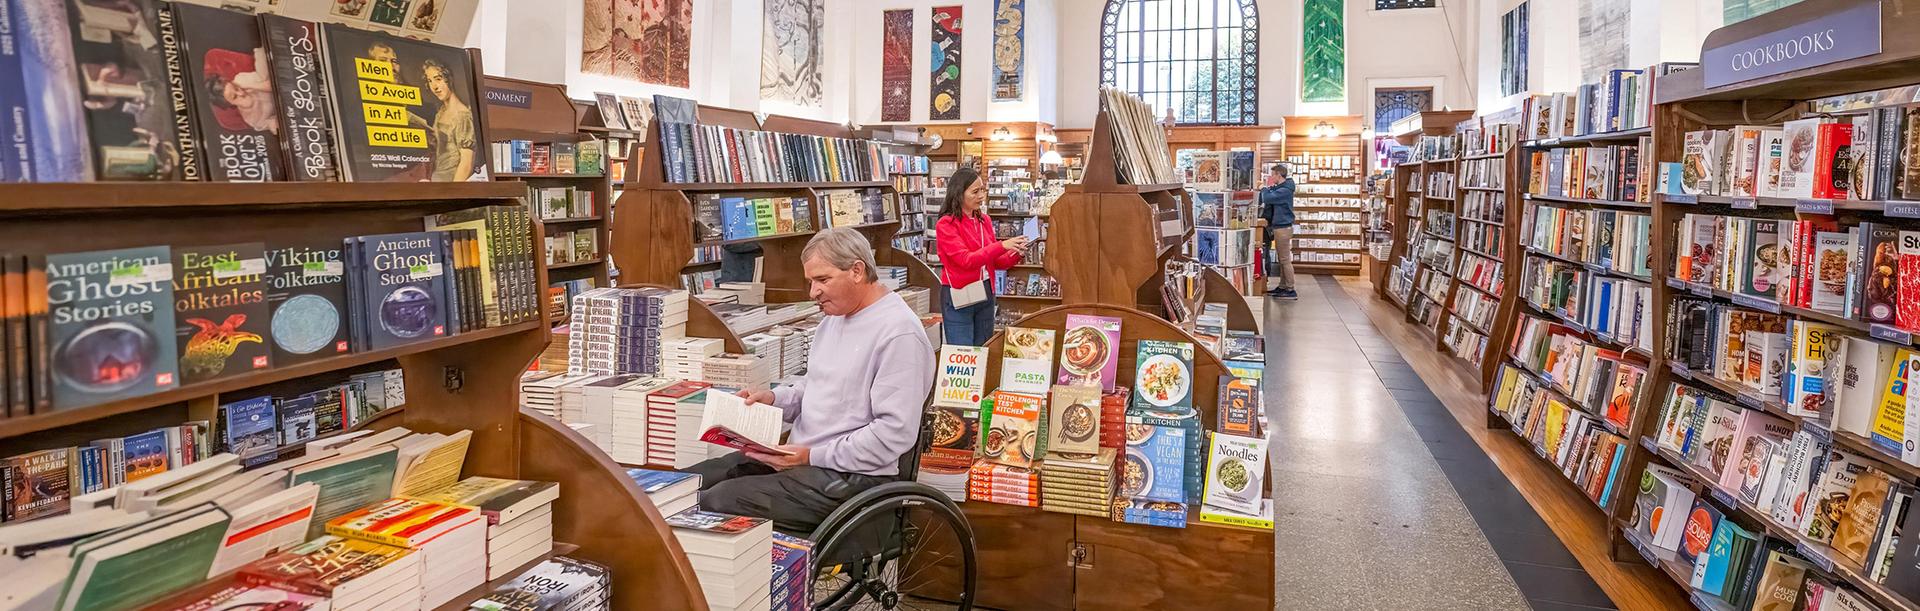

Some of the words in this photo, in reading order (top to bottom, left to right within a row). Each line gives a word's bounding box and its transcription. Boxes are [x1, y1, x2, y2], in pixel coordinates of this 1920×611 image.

[1731, 29, 1836, 72] COOKBOOKS
[158, 9, 188, 111] WOLSTENHOLME
[288, 26, 314, 112] Lovers
[361, 62, 389, 76] Men
[366, 84, 378, 96] to
[382, 87, 416, 99] Avoid
[369, 107, 381, 118] in
[384, 109, 402, 120] Art
[291, 119, 302, 151] Calendar
[373, 131, 398, 142] and
[401, 132, 420, 143] Life
[220, 134, 241, 178] BOOK
[299, 117, 325, 178] Book
[402, 155, 430, 163] Calendar
[1893, 206, 1918, 215] CHEESE
[513, 211, 521, 234] DONNA
[1757, 222, 1775, 231] EAT
[376, 238, 432, 251] Ancient
[515, 236, 523, 254] LEON
[525, 236, 533, 253] LEON
[183, 251, 238, 270] East
[264, 247, 341, 268] Viking
[373, 250, 436, 271] Ghost
[1857, 245, 1865, 267] MEAT
[46, 256, 160, 278] American
[46, 278, 163, 303] Ghost
[176, 290, 263, 312] olktales
[55, 299, 154, 324] Stories
[1883, 330, 1899, 339] MEAT
[949, 353, 978, 365] COOK
[946, 365, 976, 376] WHAT
[1015, 373, 1045, 381] PASTA
[949, 378, 971, 388] YOU
[943, 389, 971, 401] HAVE
[998, 394, 1039, 405] OTTOLENGHI
[996, 407, 1025, 415] KITCHEN
[1150, 418, 1181, 426] KITCHEN
[1721, 416, 1738, 432] Sala
[1156, 446, 1182, 458] VEGAN
[1218, 444, 1259, 462] Noodles
[1816, 442, 1832, 452] FIS
[25, 459, 31, 467] A
[33, 453, 55, 465] WALK
[57, 450, 66, 459] IN
[1787, 447, 1800, 481] BUTCHERY
[1792, 451, 1805, 485] BUTCHERY
[18, 502, 36, 512] KEVIN
[367, 501, 421, 522] BURNING
[1687, 519, 1712, 546] SOUPS
[520, 585, 551, 595] CAST
[523, 574, 569, 592] IRON
[564, 590, 581, 606] CAST
[578, 584, 595, 598] IRON
[1836, 592, 1849, 606] Six
